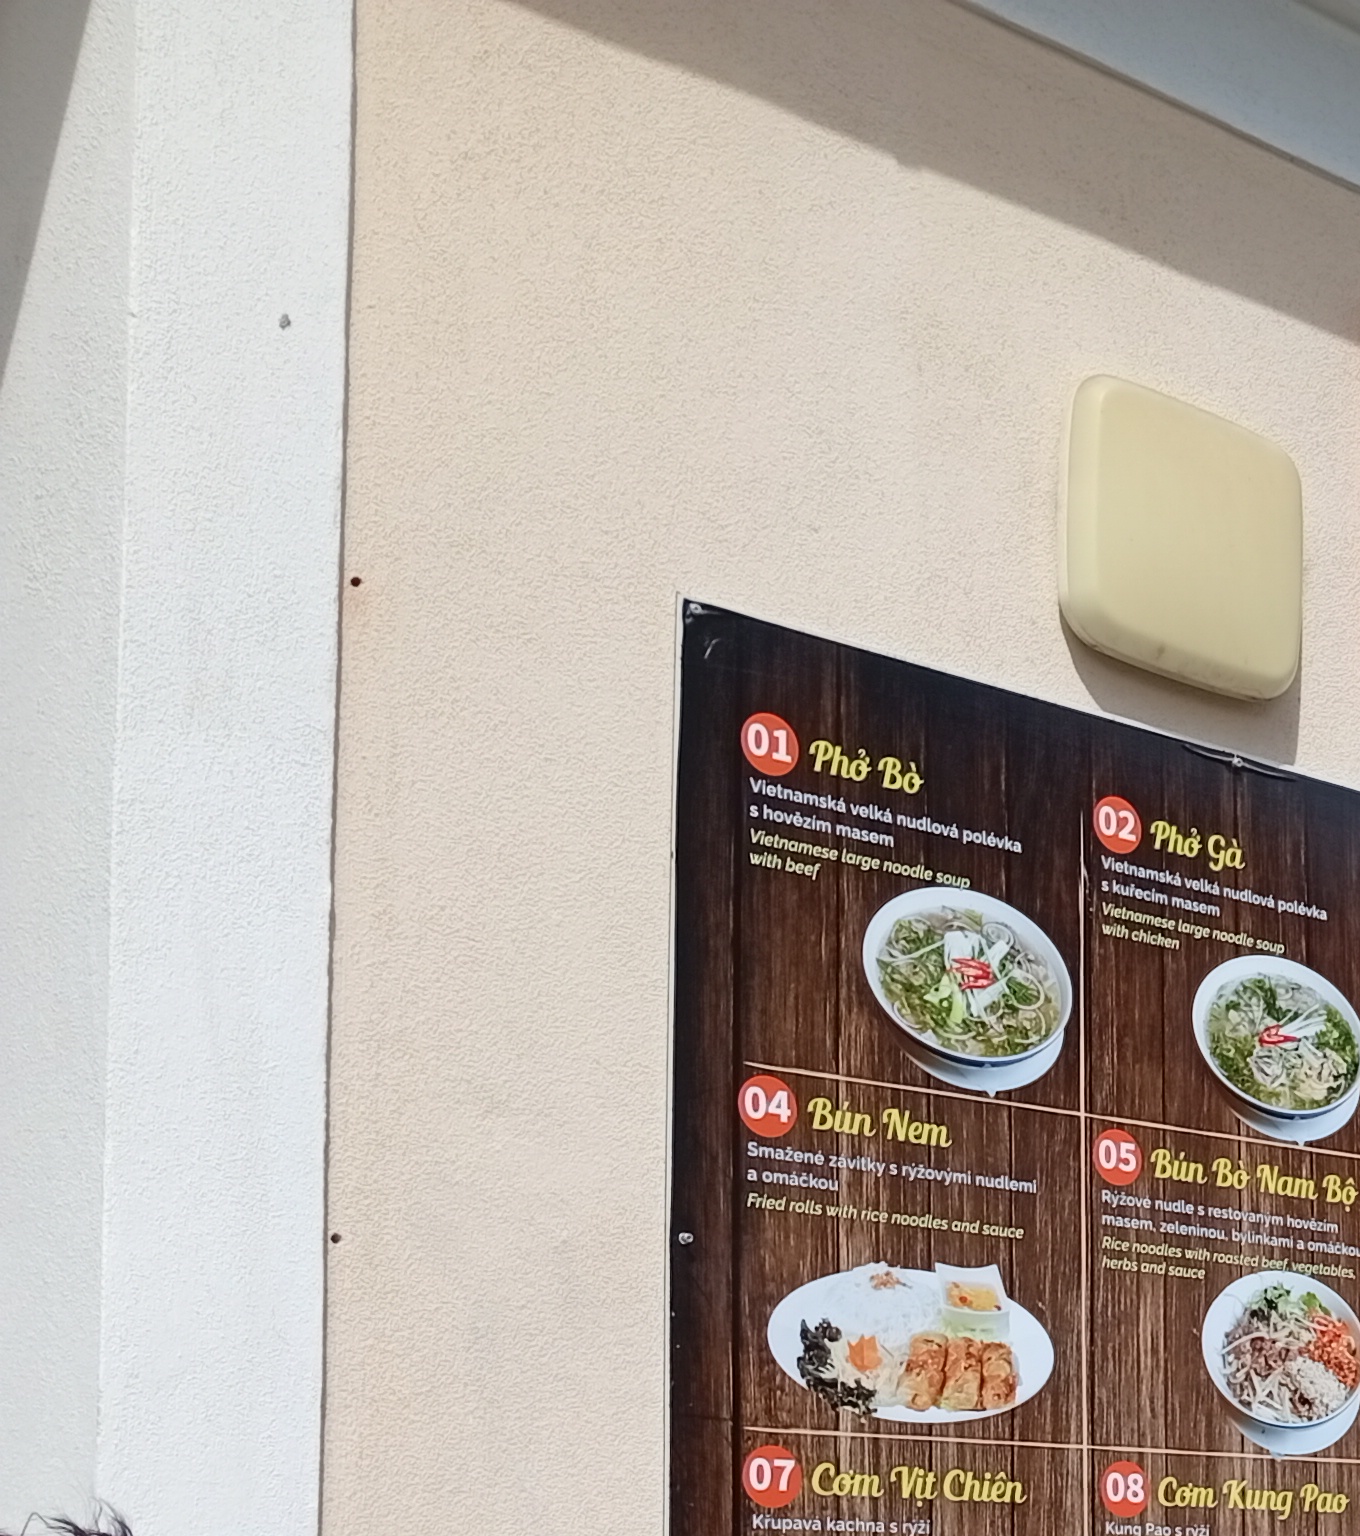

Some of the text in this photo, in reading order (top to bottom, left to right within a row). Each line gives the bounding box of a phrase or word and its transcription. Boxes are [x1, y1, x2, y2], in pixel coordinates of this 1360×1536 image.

[747, 723, 924, 794] 01 Phở Bò
[750, 778, 1022, 854] Vietnamská velká nudlová polévka
[750, 804, 894, 847] s hovězím masem
[1099, 806, 1136, 841] 02
[1208, 834, 1245, 871] Gà
[750, 829, 970, 890] Vietnamese large noodle soup
[750, 853, 821, 880] with beef
[744, 1086, 952, 1148] 04 Bún Nem
[747, 1142, 1037, 1194] Smažené závitky s rýžovými nudlemi
[747, 1170, 839, 1192] a omáčkou
[1099, 1139, 1137, 1173] 05
[1150, 1148, 1208, 1185] Bún
[1212, 1157, 1250, 1190] Bò
[1256, 1163, 1318, 1200] Nam
[747, 1193, 1024, 1239] Fried rolls with rice noodles and sauce
[749, 1457, 795, 1491] 07
[890, 1466, 938, 1507] Vịt
[943, 1469, 1027, 1504] Chiên
[1106, 1472, 1144, 1503] 08
[1223, 1479, 1293, 1520] Kung
[1300, 1484, 1350, 1514] Pao
[827, 1517, 885, 1533] kachna
[890, 1522, 897, 1534] s
